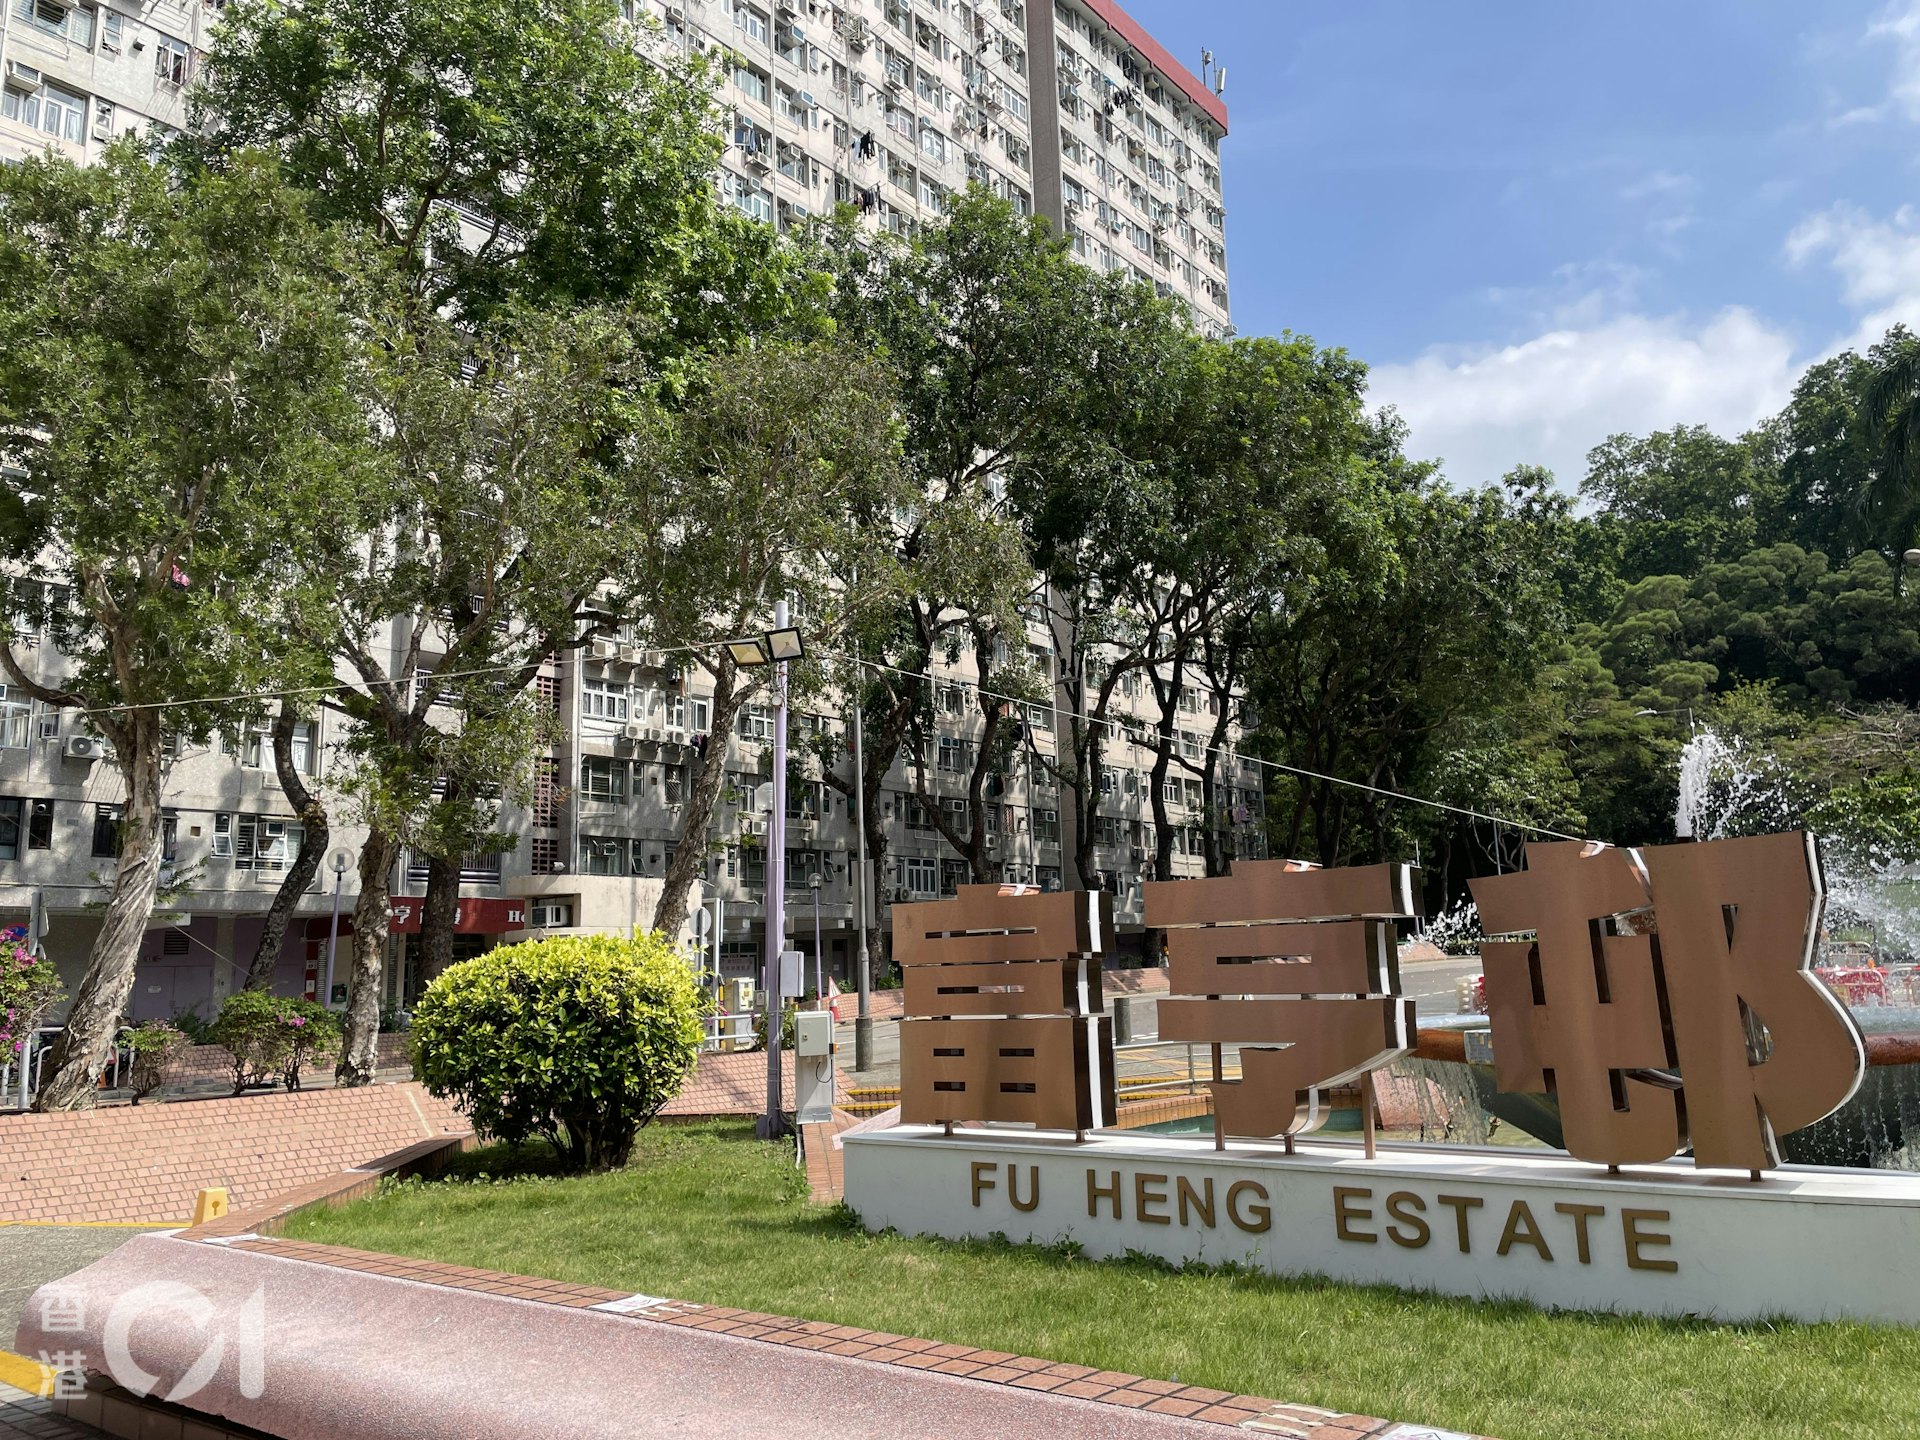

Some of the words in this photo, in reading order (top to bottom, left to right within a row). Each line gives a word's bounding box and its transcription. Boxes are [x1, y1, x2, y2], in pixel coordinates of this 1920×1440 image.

[892, 831, 1867, 1170] 富亨邨
[970, 1161, 1040, 1212] FU
[1086, 1168, 1272, 1233] HENG
[1333, 1186, 1679, 1273] ESTATE
